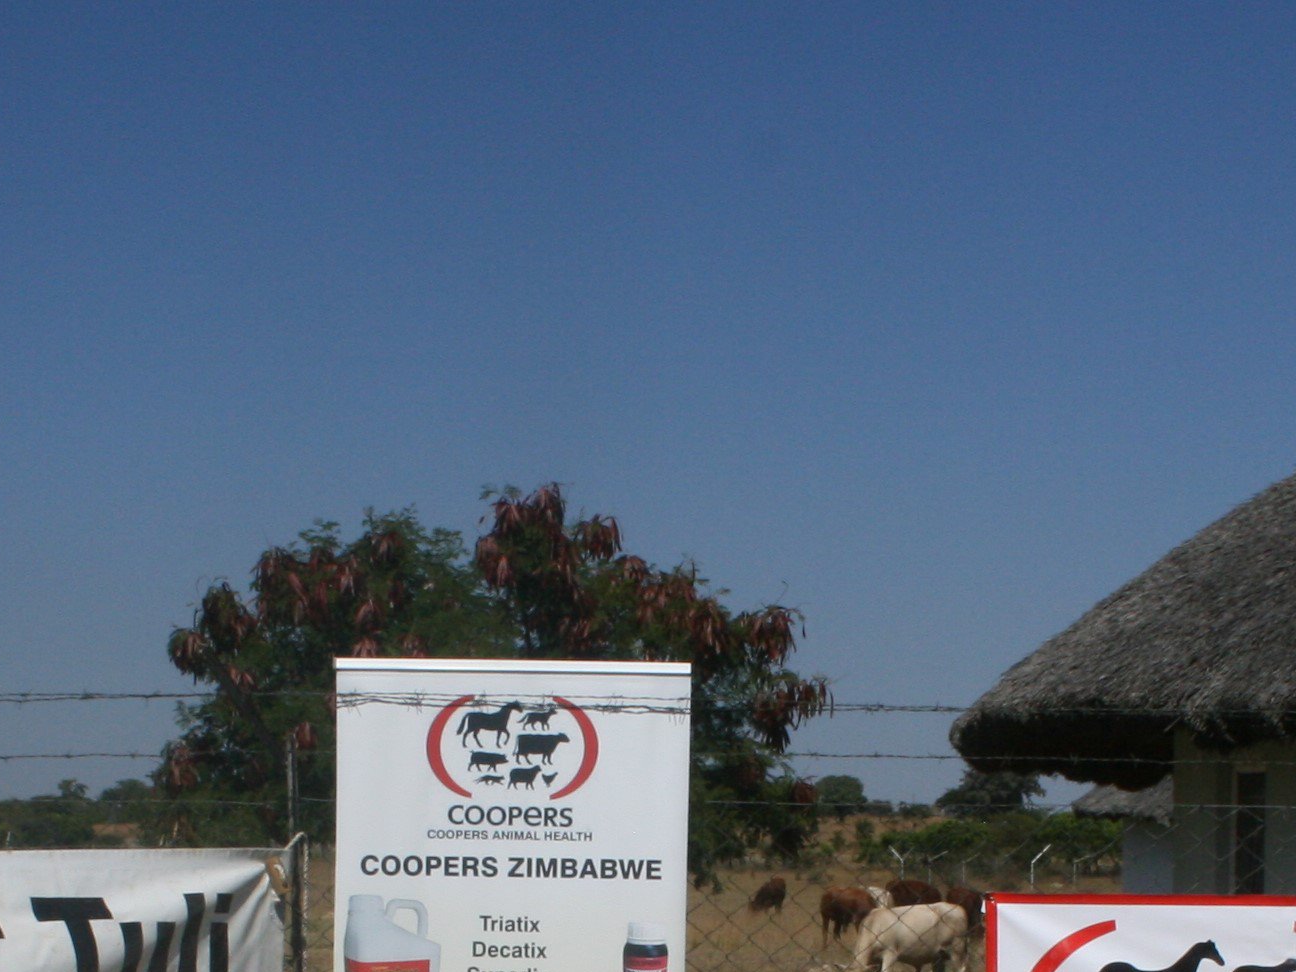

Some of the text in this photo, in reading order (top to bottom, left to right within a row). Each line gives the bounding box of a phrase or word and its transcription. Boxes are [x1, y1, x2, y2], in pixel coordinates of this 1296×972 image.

[427, 829, 593, 842] COOPERS ANIMAL HEALTH
[360, 855, 663, 881] COOPERS ZIMBABWE
[479, 915, 540, 933] Triatix
[471, 941, 547, 959] Decatix
